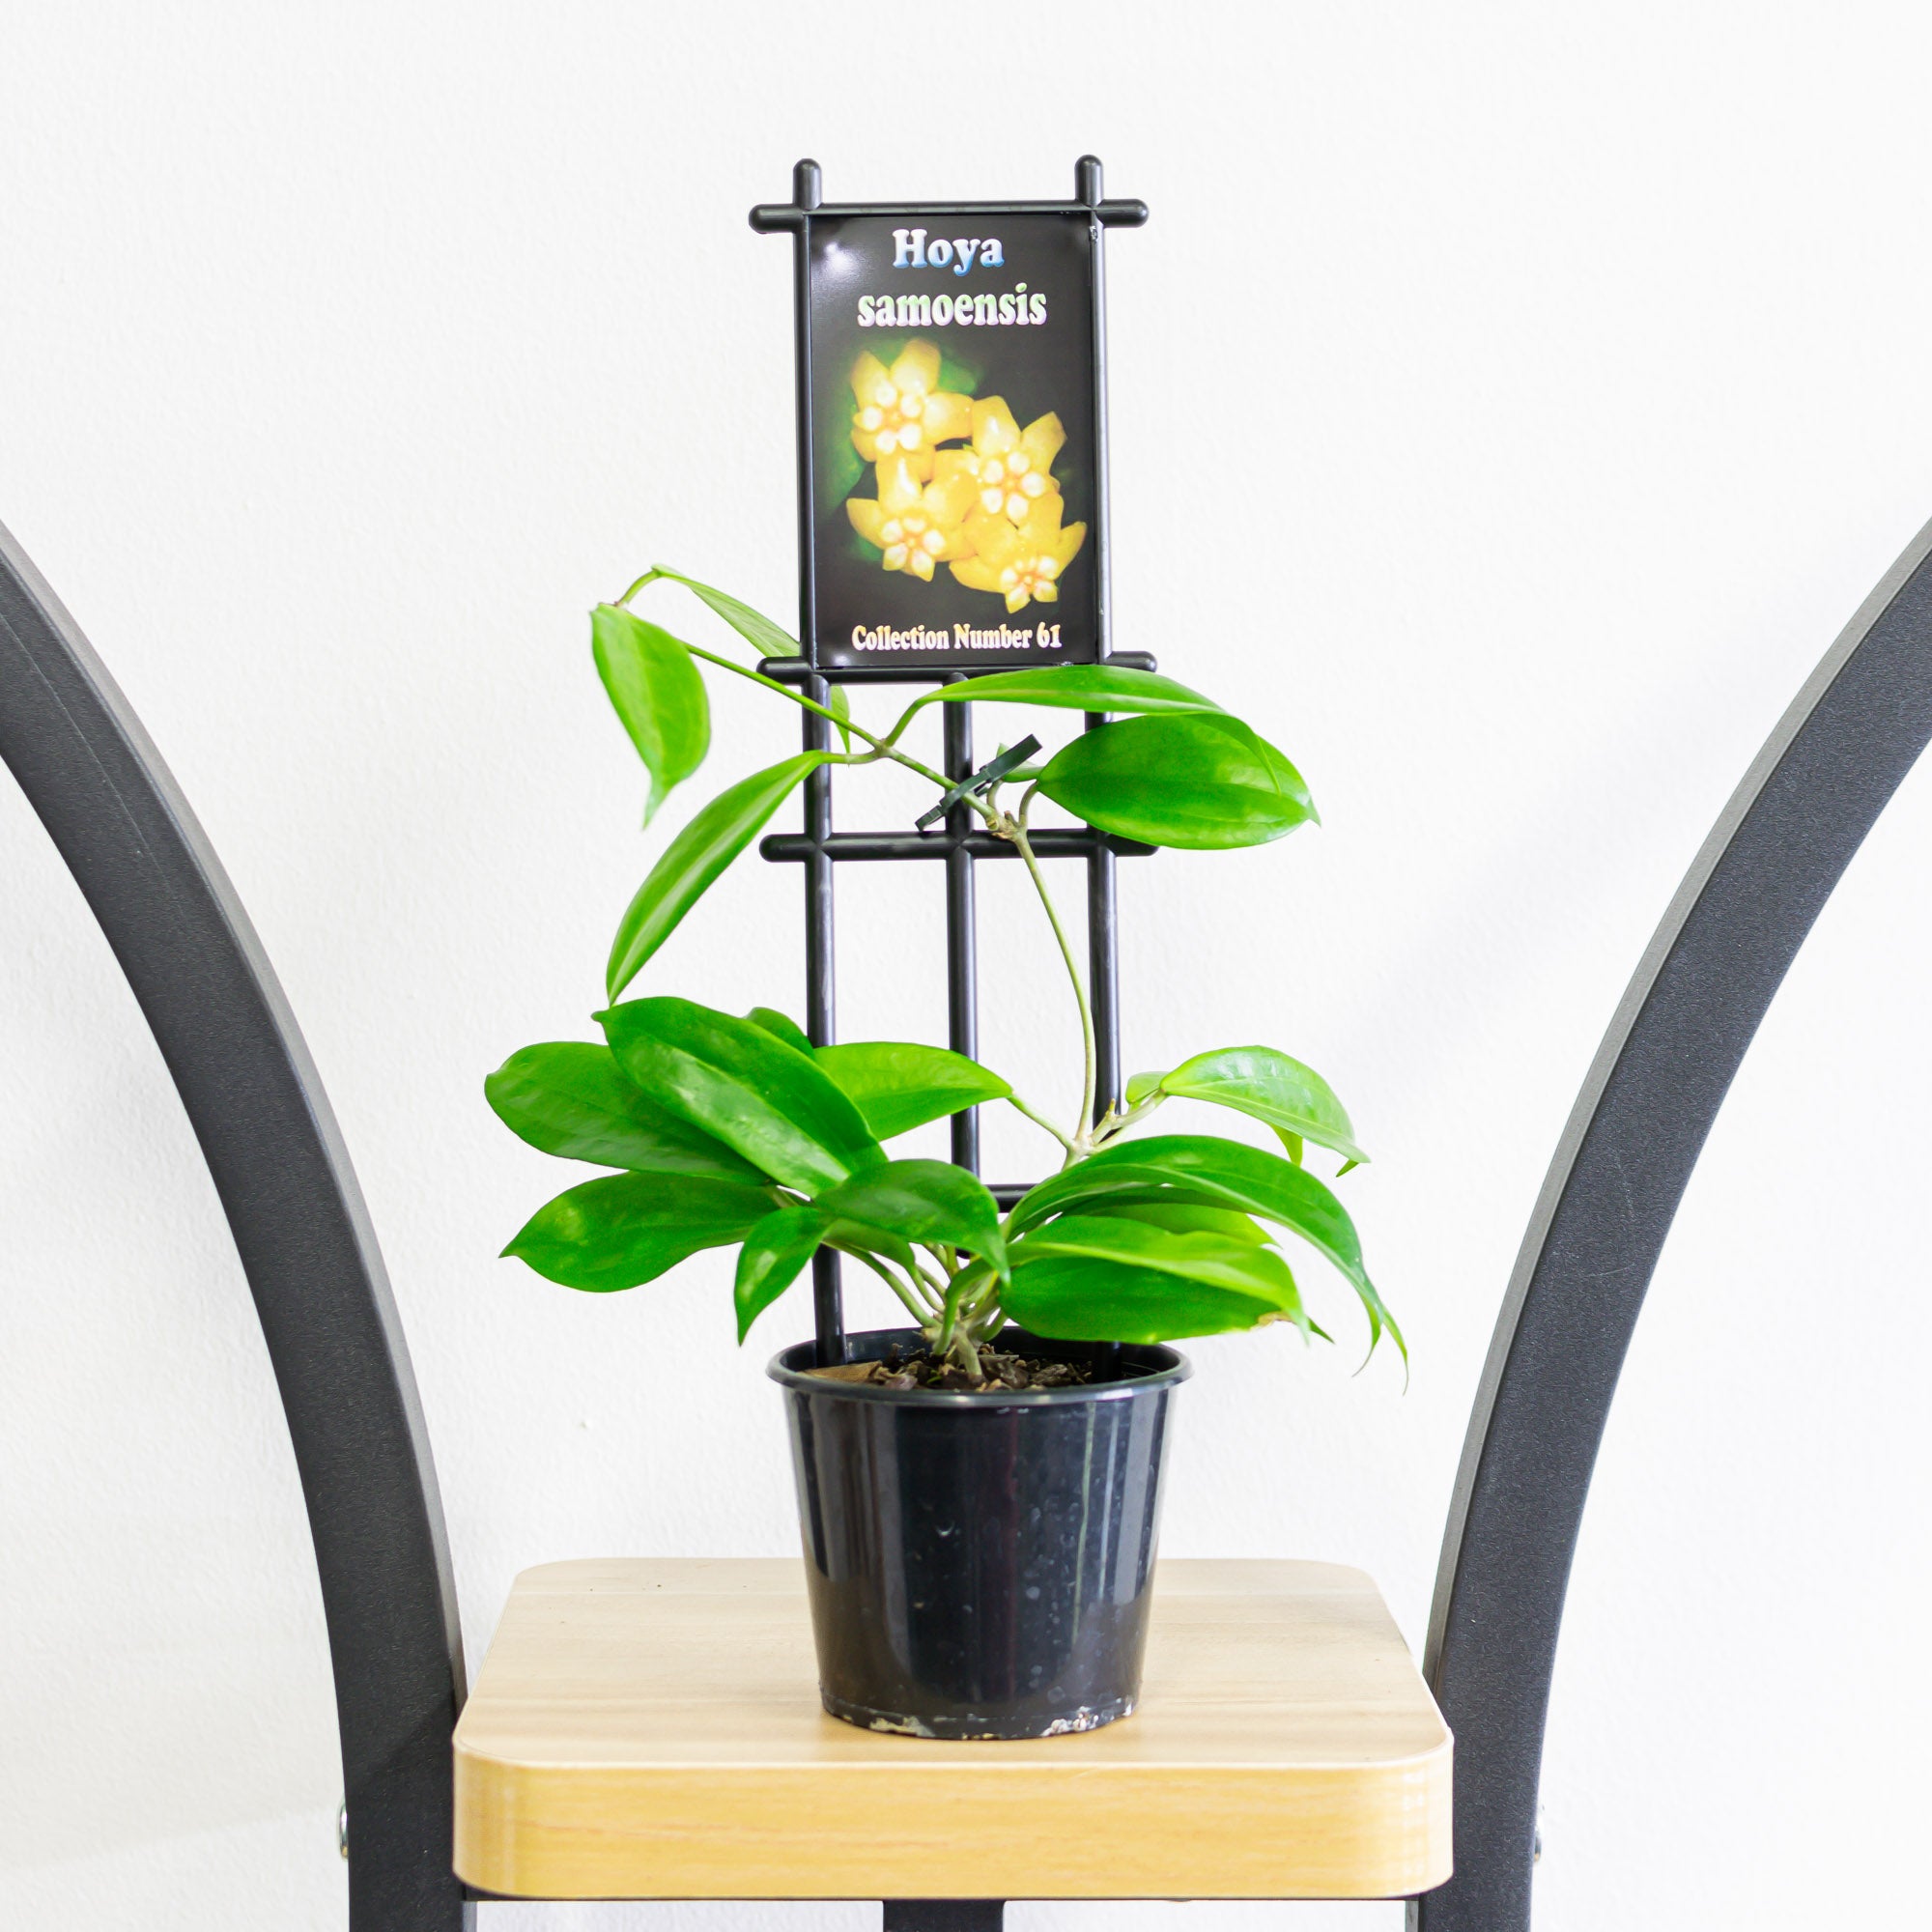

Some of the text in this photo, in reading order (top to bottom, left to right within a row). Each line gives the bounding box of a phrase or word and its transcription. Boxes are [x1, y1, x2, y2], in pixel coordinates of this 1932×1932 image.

[892, 228, 1005, 276] Hoya
[857, 282, 1047, 327] samoensis
[852, 621, 1063, 651] Collection Number 61
